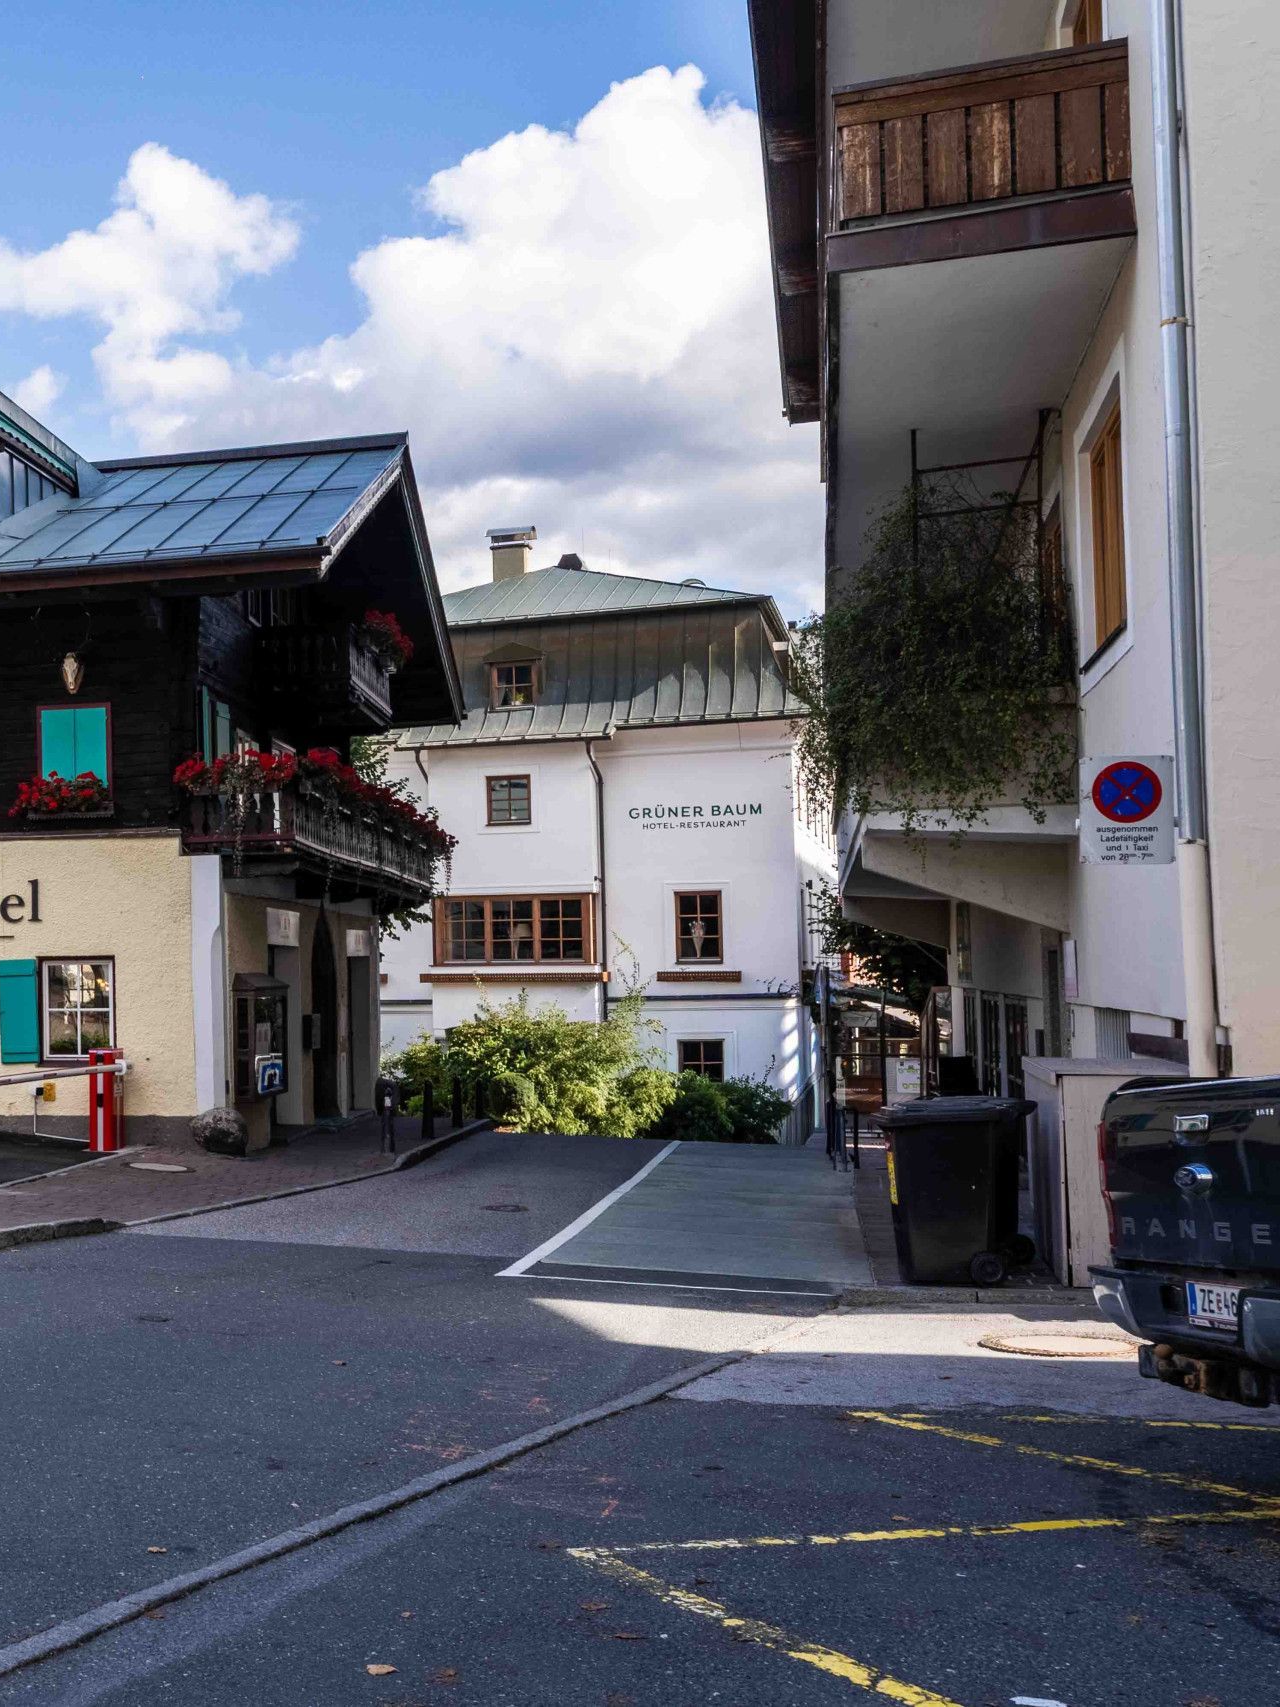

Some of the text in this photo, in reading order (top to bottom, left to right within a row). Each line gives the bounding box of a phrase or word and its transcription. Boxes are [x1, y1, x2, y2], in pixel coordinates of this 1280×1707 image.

[628, 803, 763, 819] GRÜNER BAUM
[642, 820, 747, 830] HOTEL-RESTAURANT
[1096, 826, 1159, 834] ausgenommen
[1100, 834, 1154, 843] Ladetätigkeit
[1133, 843, 1149, 851] Taxi
[1199, 1288, 1215, 1313] ZE
